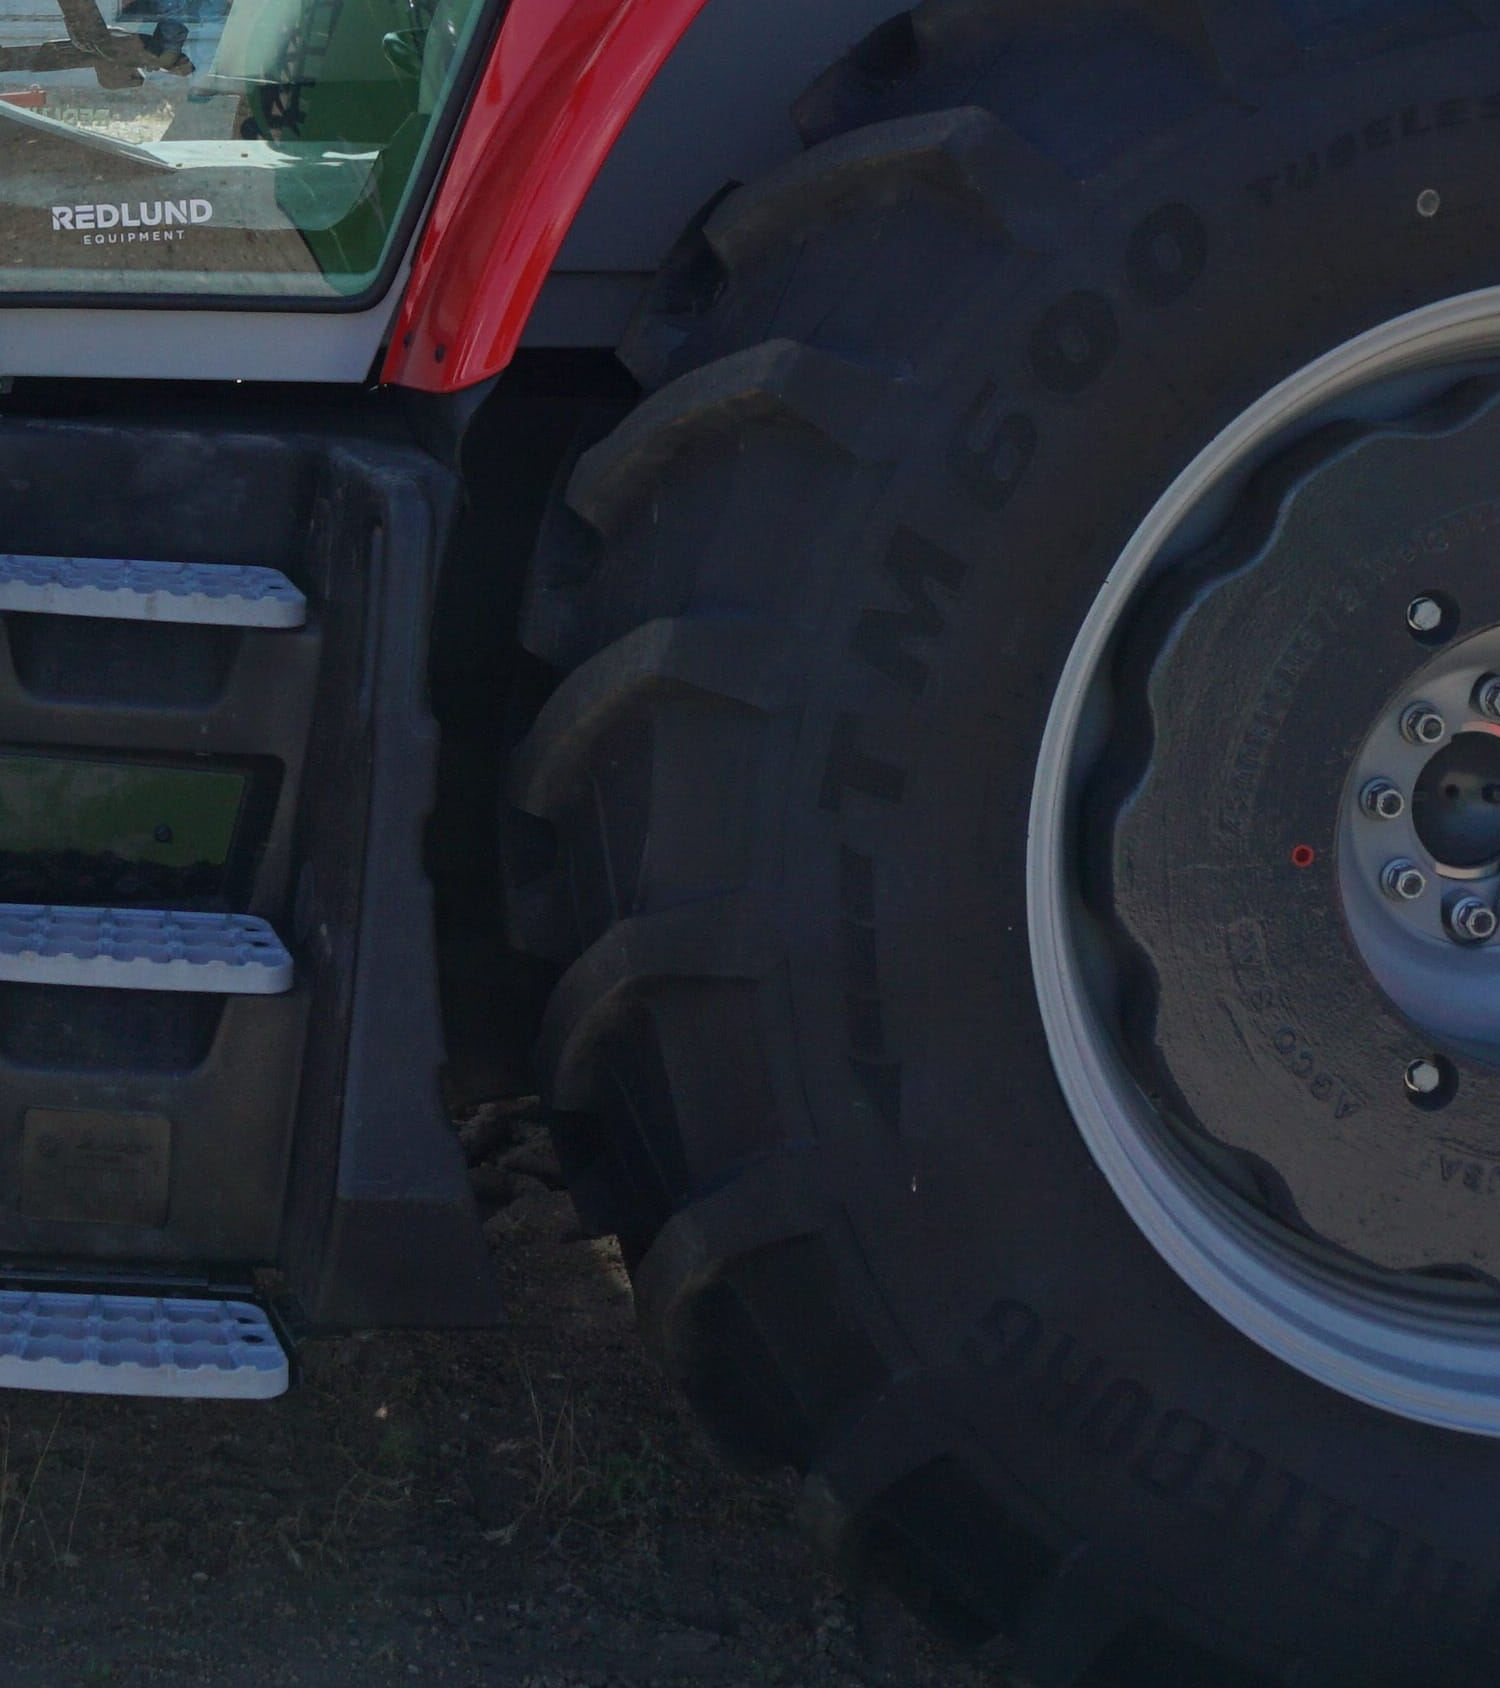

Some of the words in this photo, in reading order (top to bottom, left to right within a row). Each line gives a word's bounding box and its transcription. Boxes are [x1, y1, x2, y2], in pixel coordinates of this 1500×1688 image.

[51, 198, 214, 231] REDLUND
[83, 229, 186, 246] EQUIPMENT
[946, 201, 1207, 508] 600
